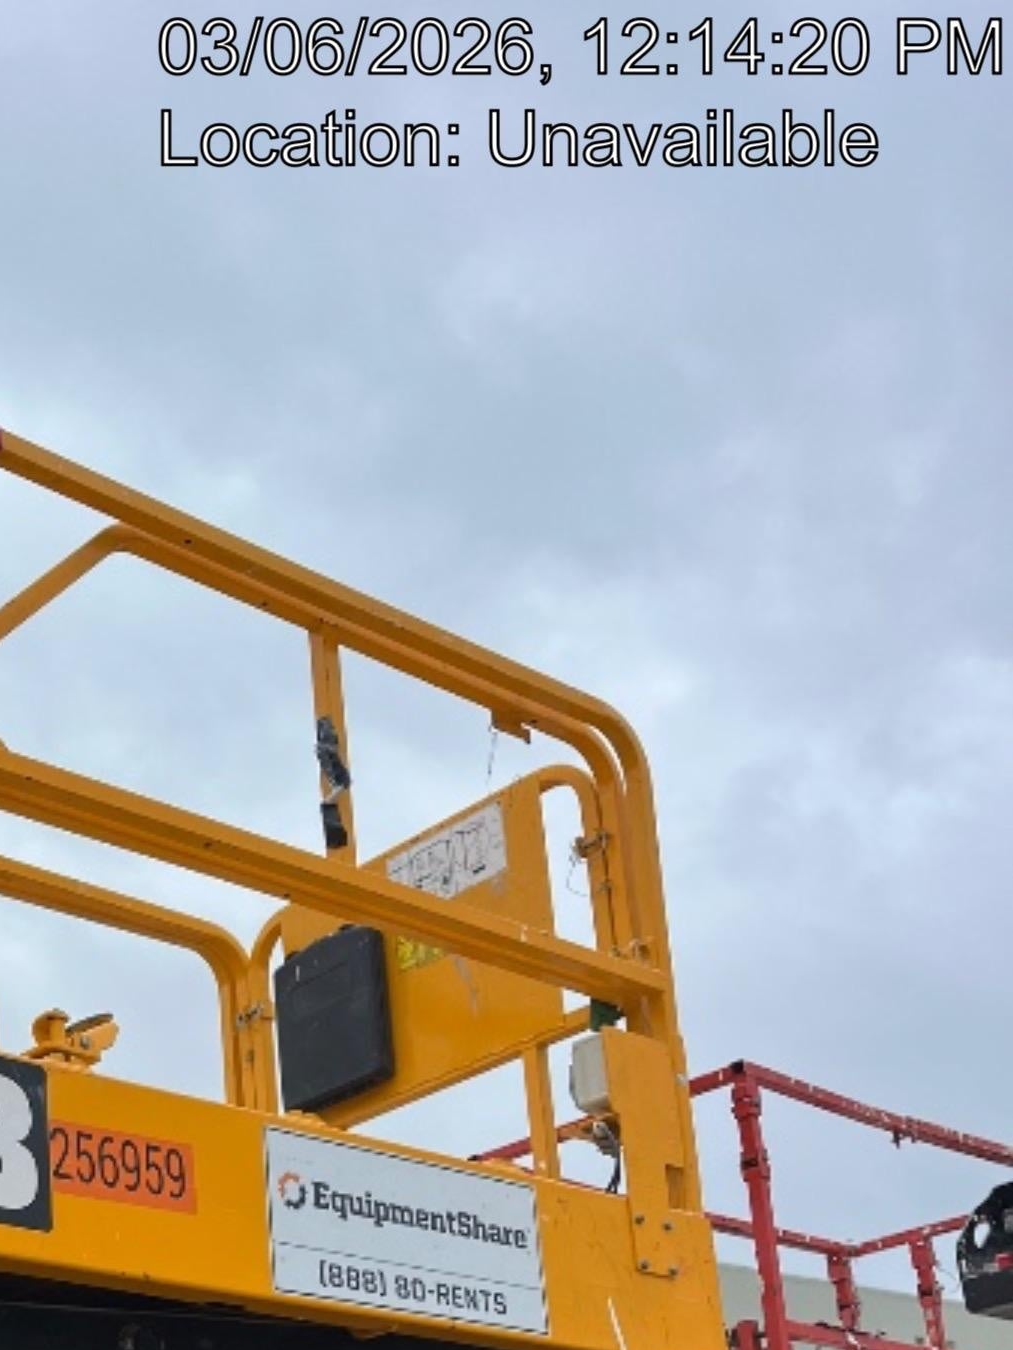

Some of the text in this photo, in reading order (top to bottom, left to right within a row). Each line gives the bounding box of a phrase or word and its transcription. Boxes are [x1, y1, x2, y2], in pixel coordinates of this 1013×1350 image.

[50, 1127, 187, 1199] 256959
[311, 1181, 528, 1249] EquipmentShare
[319, 1260, 508, 1315] (888) 80-RENTS
